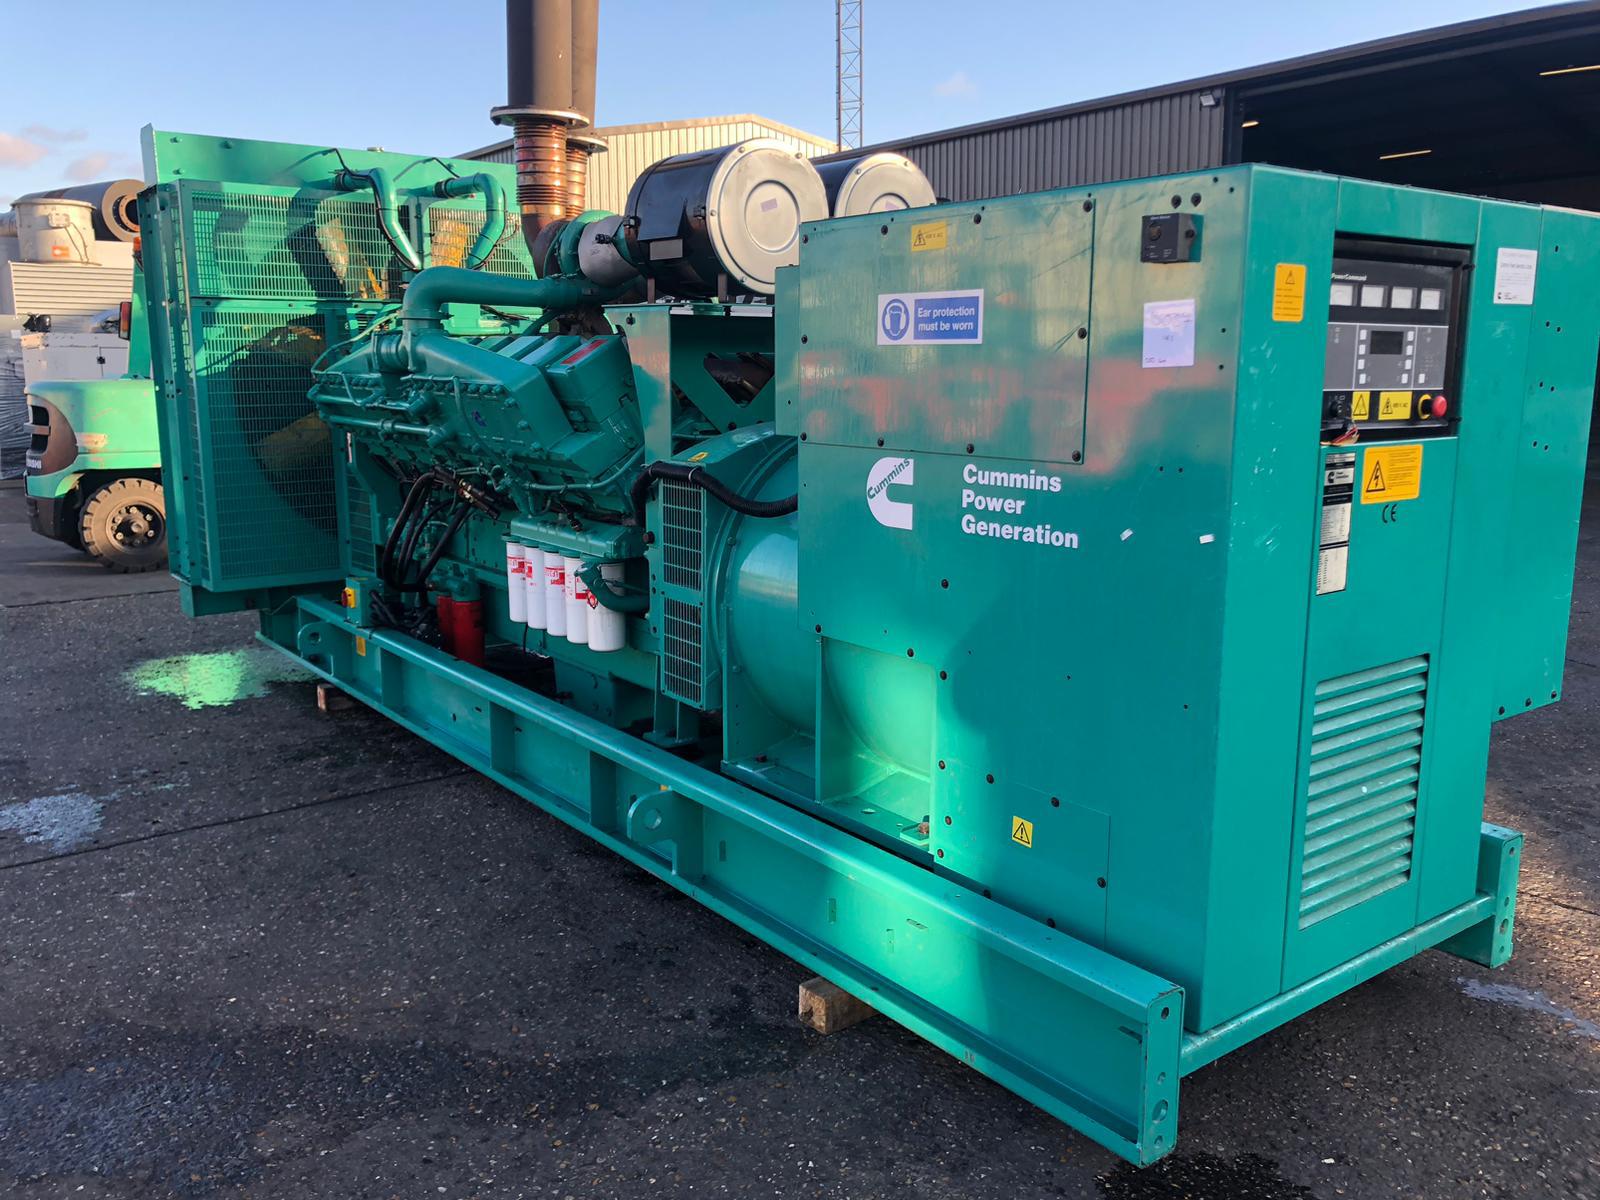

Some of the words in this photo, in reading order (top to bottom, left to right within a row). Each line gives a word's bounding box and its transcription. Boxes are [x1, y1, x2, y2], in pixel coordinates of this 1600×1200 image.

[918, 308, 931, 318] Ear
[932, 306, 975, 318] protection
[918, 322, 938, 331] must
[940, 321, 950, 330] be
[952, 322, 974, 330] worn
[866, 457, 911, 500] Cummins
[962, 464, 1062, 492] Cummins
[962, 489, 1025, 514] Power
[1382, 504, 1397, 524] CE
[961, 514, 1079, 548] Generation
